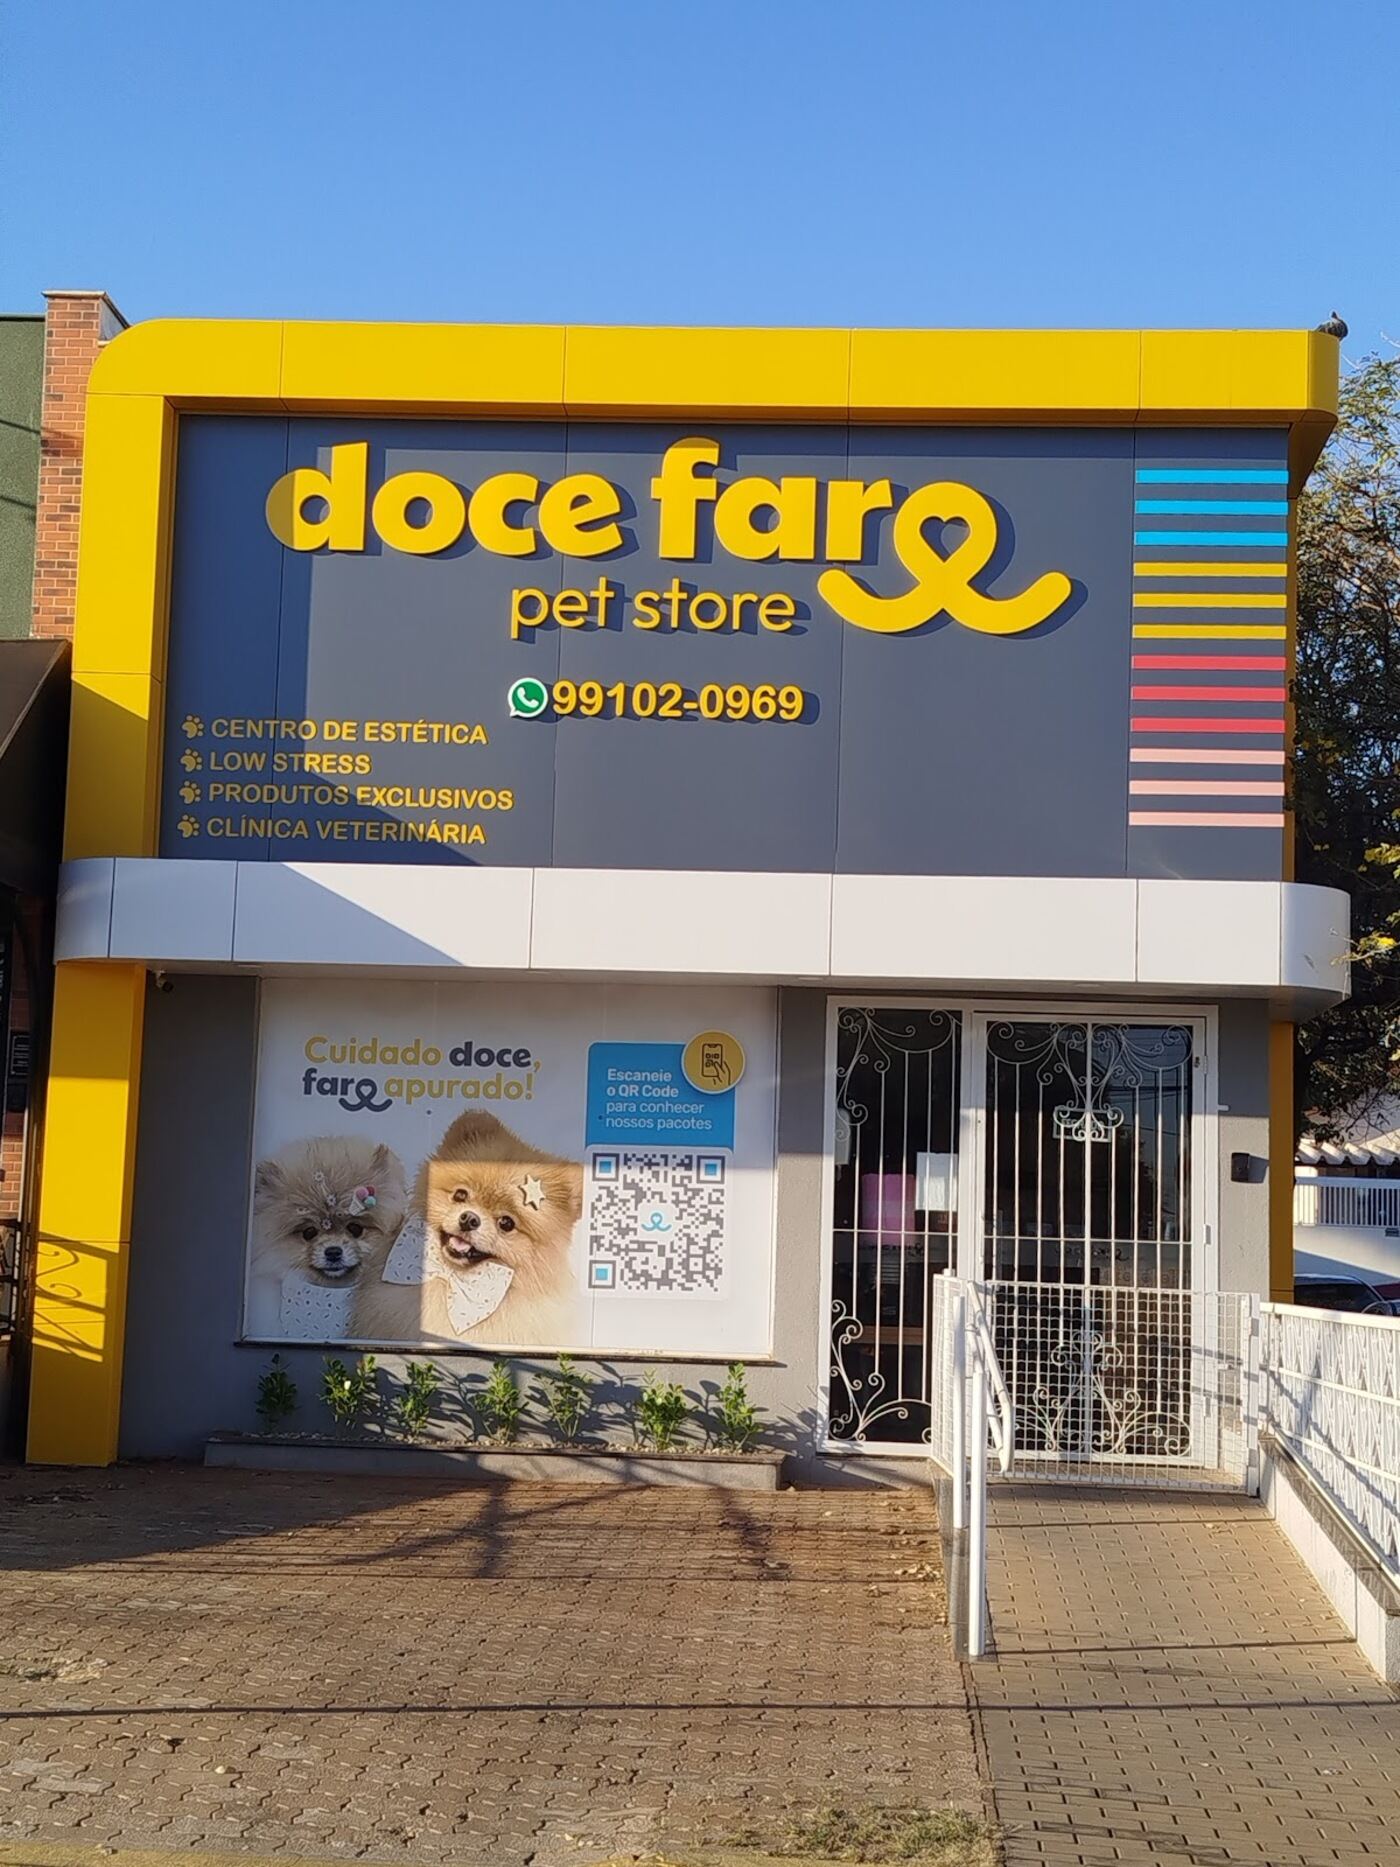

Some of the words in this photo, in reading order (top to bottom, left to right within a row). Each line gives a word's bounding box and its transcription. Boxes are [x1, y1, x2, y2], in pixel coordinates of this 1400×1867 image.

[266, 441, 623, 556] doce
[511, 576, 614, 639] pet
[632, 577, 795, 631] store
[552, 680, 803, 720] 99102-0969
[211, 719, 316, 741] CENTRO
[323, 720, 357, 742] DE
[364, 719, 487, 745] ESTÉTICA
[210, 752, 266, 771] LOW
[273, 752, 371, 774] STRESS
[209, 783, 348, 805] PRODUTOS
[356, 786, 513, 810] EXCLUSIVOS
[207, 815, 308, 838] CLÍNICA
[316, 819, 486, 844] VETERINÁRIA
[304, 1035, 442, 1065] Cuidado
[449, 1041, 541, 1072] doce,
[607, 1068, 672, 1081] Escaneie
[384, 1073, 535, 1104] apurado!
[606, 1086, 616, 1096] o
[618, 1084, 639, 1097] QR
[642, 1084, 679, 1097] Code
[606, 1102, 636, 1114] para
[640, 1101, 704, 1114] conhecer
[606, 1117, 654, 1129] nossos
[657, 1117, 712, 1131] pacotes
